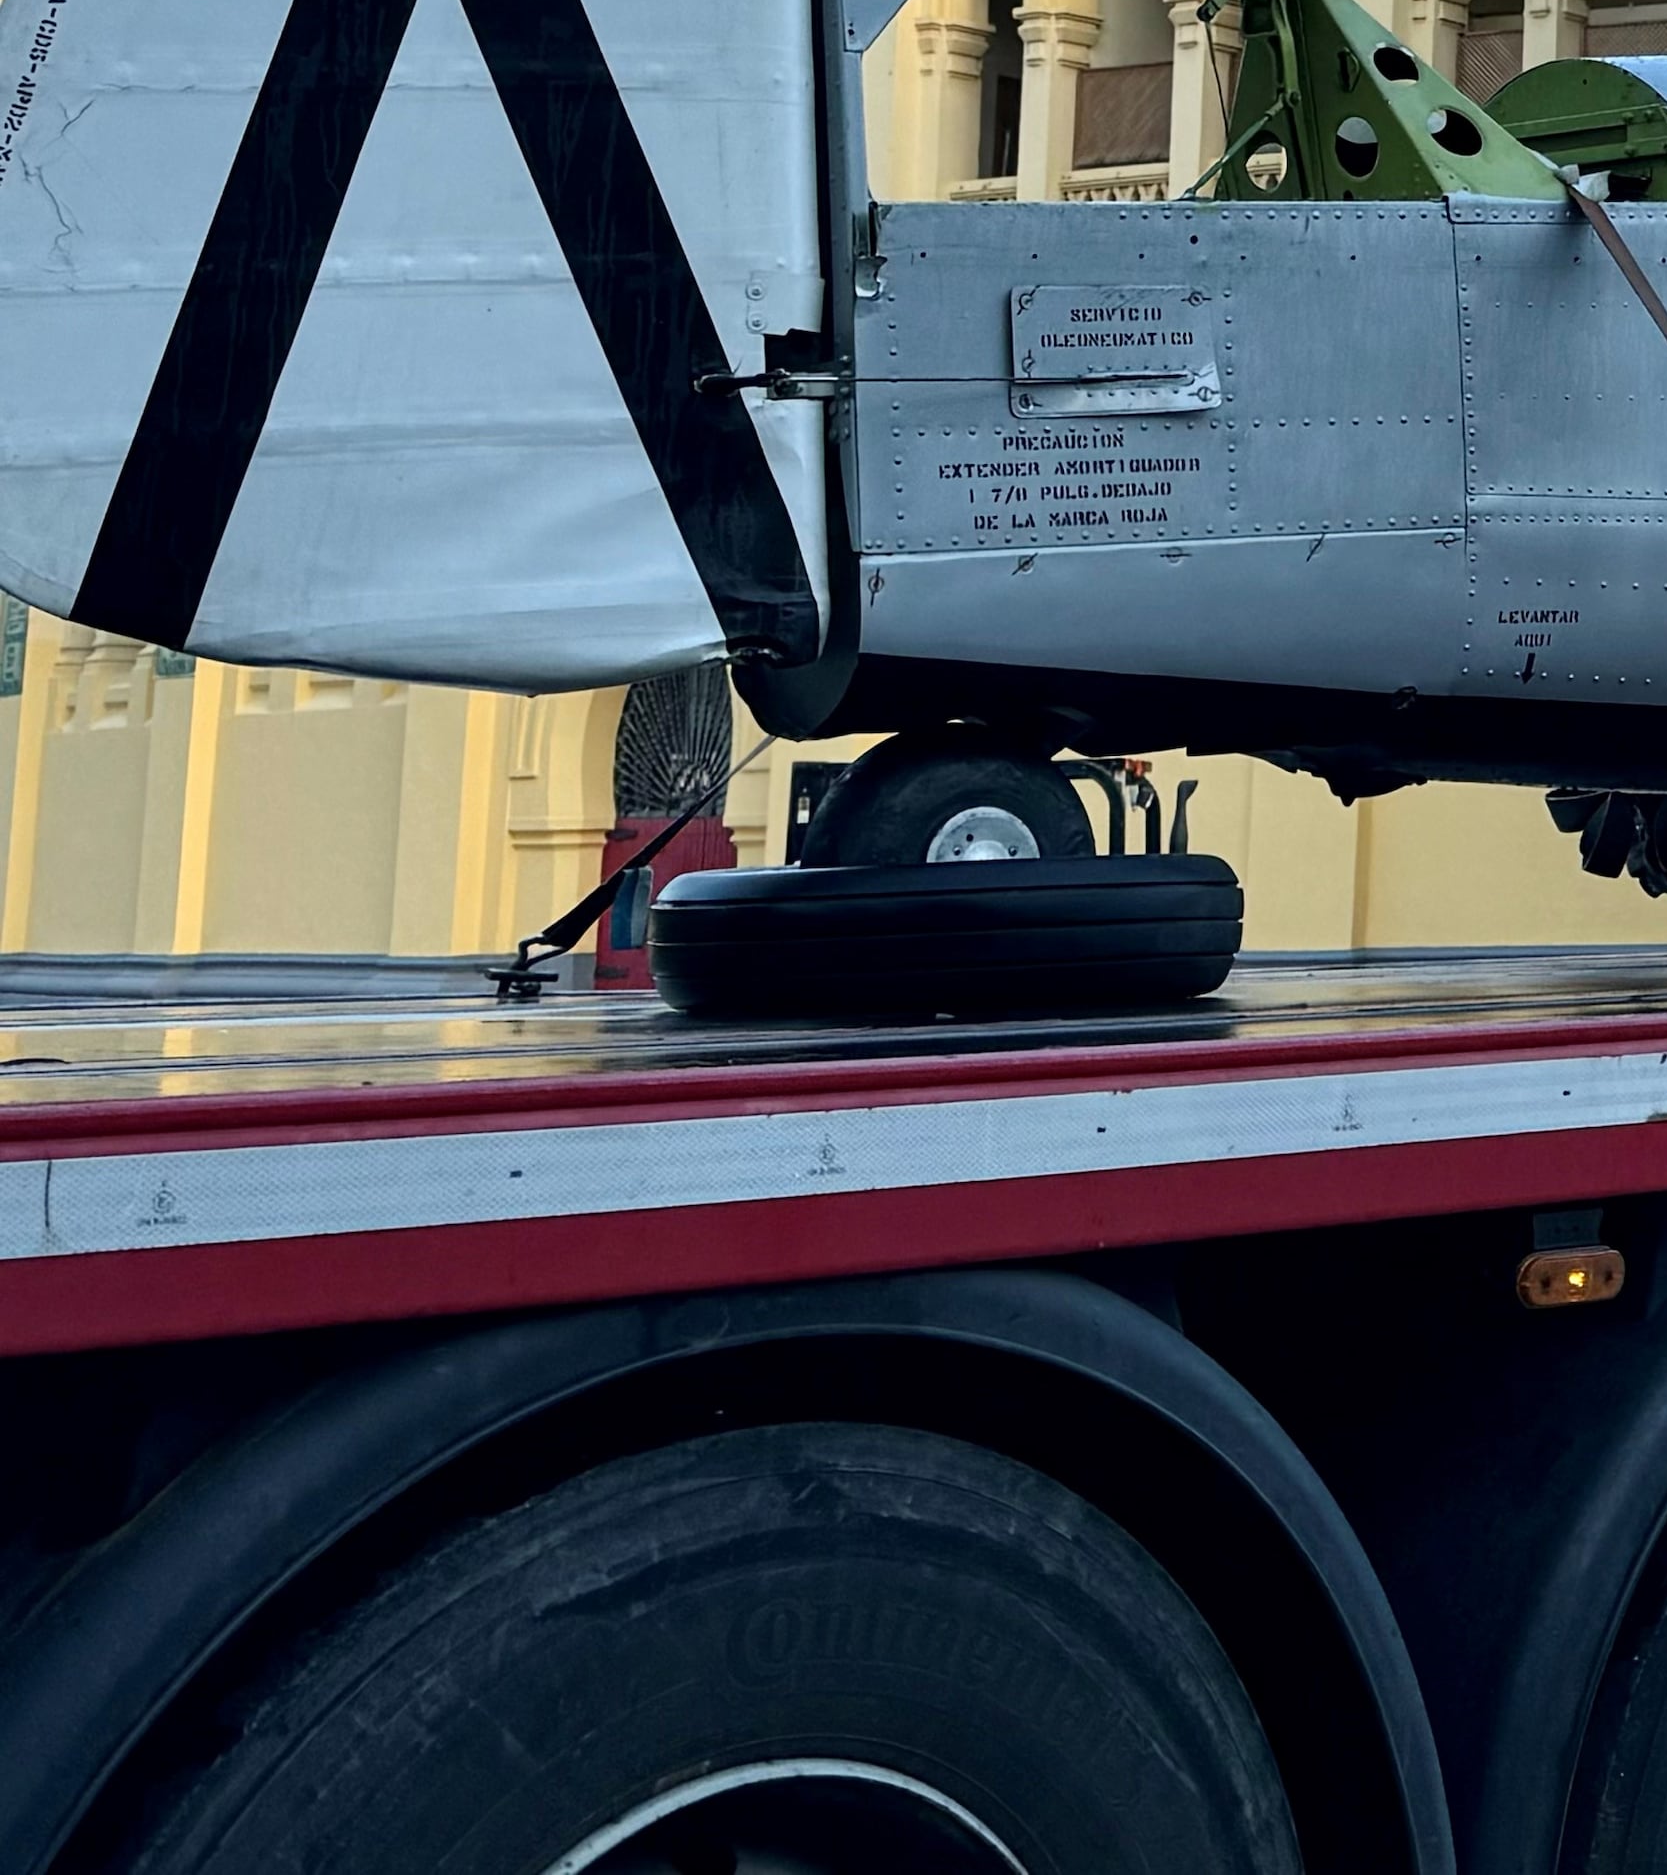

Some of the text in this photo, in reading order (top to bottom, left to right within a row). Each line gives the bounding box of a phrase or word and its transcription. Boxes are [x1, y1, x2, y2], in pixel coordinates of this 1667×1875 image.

[1070, 307, 1162, 323] SERVICIO
[1040, 332, 1193, 348] OLEONEUMATICO
[1003, 434, 1125, 451] PRECAUCION
[938, 462, 1040, 479] EXTENDER
[974, 508, 1168, 530] DE LA MARCA ROJA
[1498, 610, 1579, 624] LEVANTAR
[1514, 633, 1552, 648] AQUI
